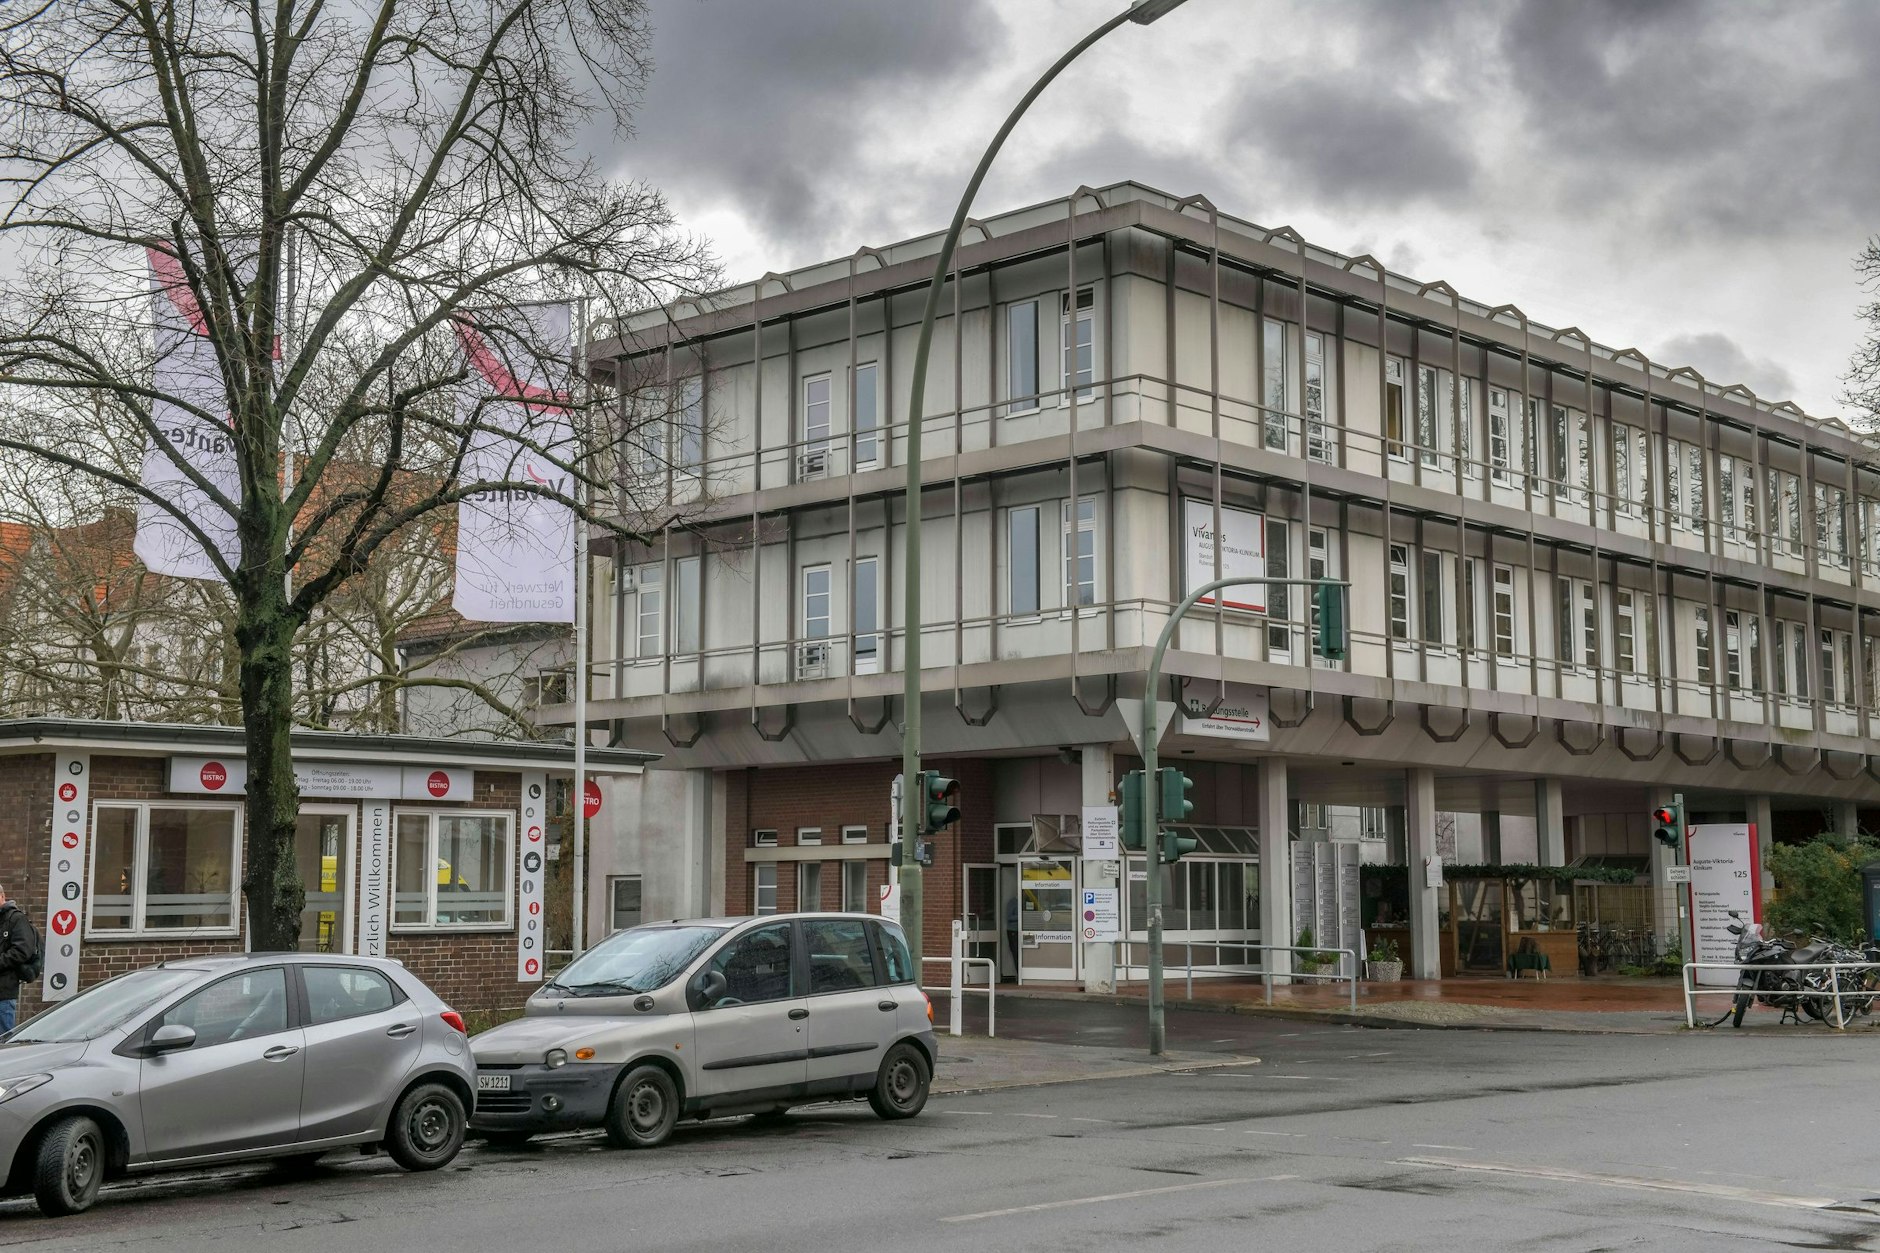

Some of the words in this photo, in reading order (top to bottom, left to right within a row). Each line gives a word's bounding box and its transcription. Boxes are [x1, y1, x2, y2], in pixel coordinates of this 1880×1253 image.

[1192, 523, 1227, 543] Vivans
[584, 797, 600, 806] STRO
[368, 808, 383, 910] Willkommen
[1733, 870, 1748, 878] 125
[367, 914, 380, 957] rzlich
[490, 1076, 509, 1089] 1211
